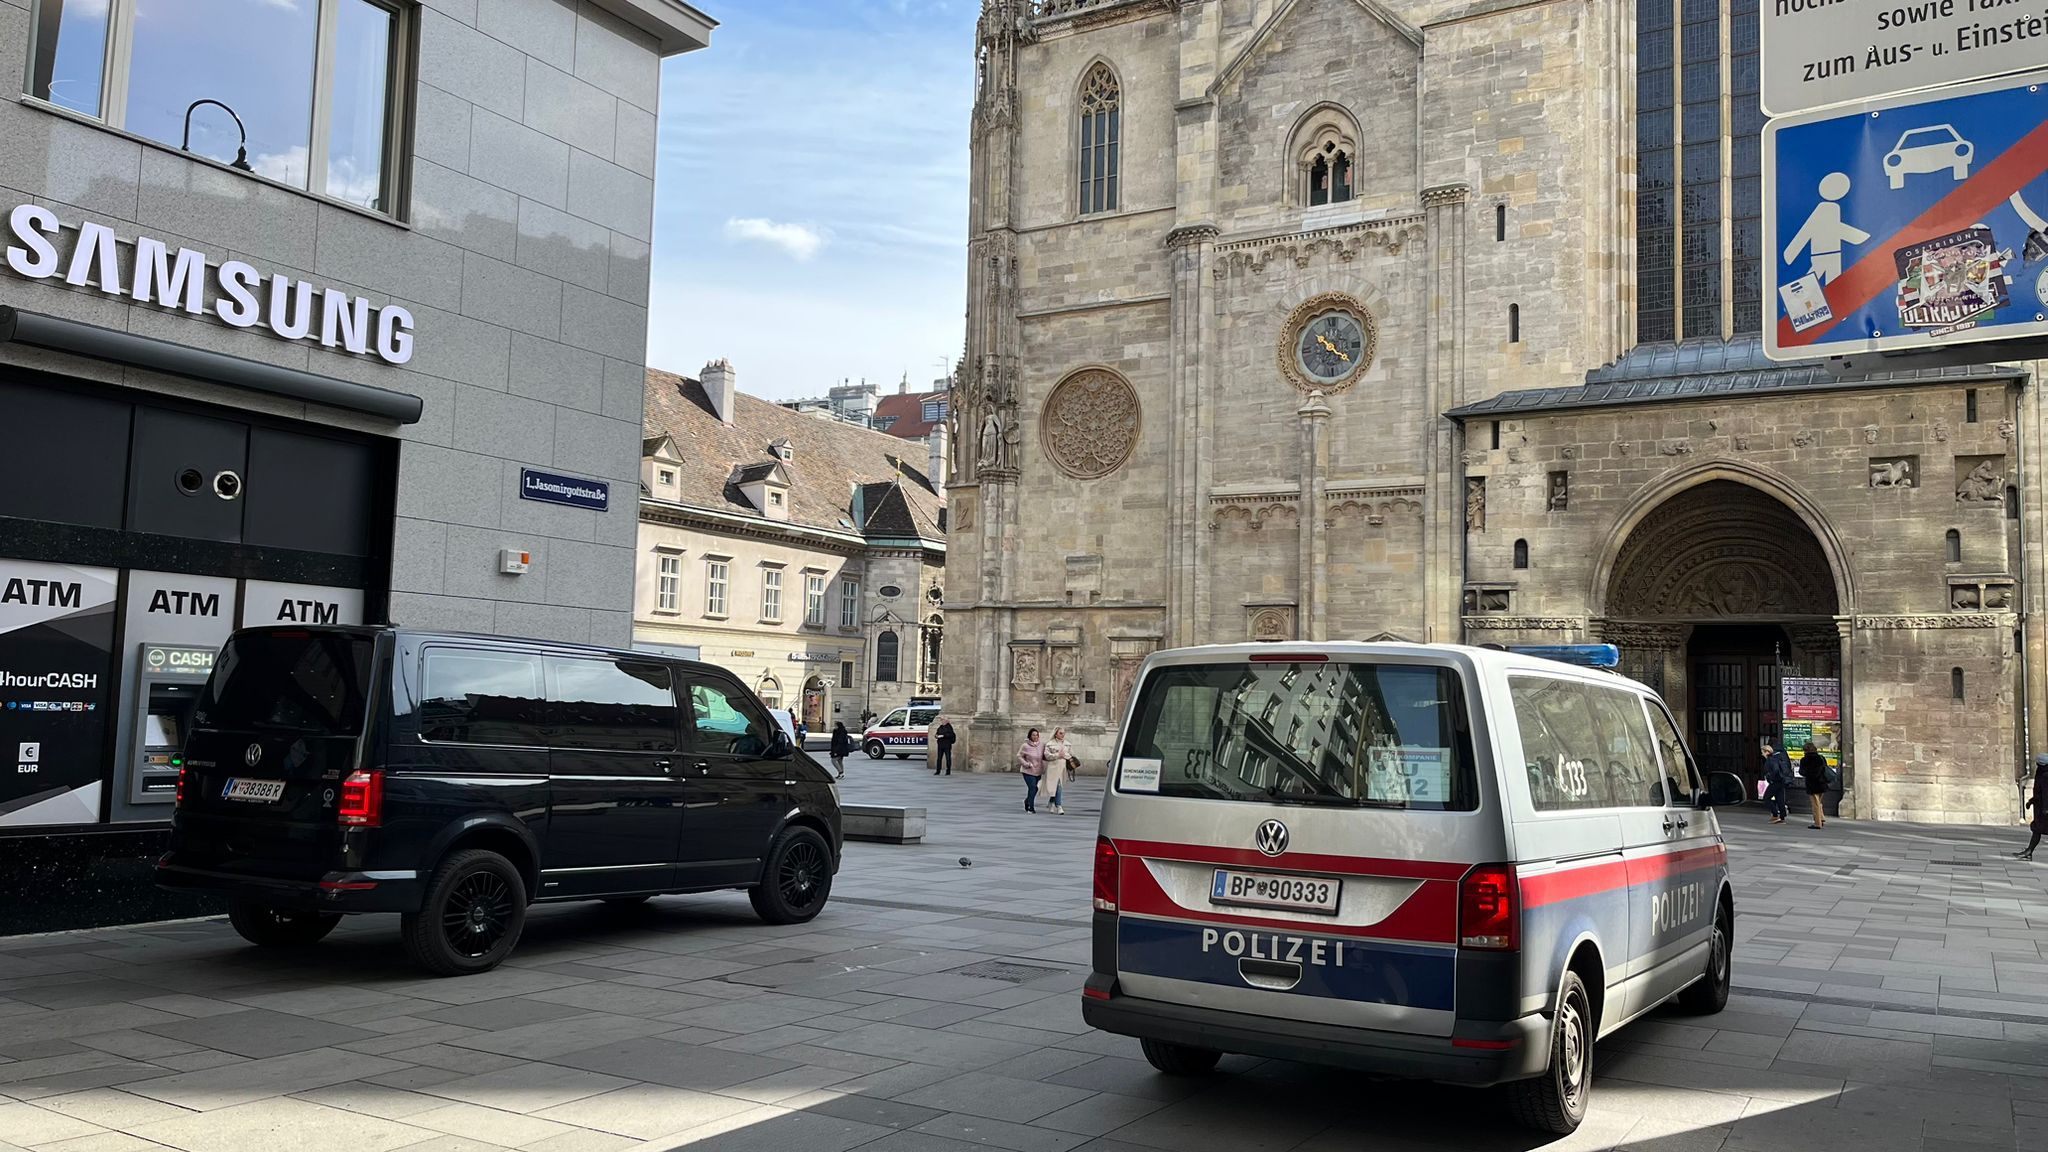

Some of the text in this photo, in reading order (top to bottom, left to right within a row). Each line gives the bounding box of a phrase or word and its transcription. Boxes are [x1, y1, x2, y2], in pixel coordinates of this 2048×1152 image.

[1877, 0, 1954, 30] sowie
[1803, 54, 1855, 82] zum
[1865, 43, 1923, 69] Aus-
[1933, 42, 1949, 57] u.
[6, 204, 415, 364] SAMSUNG
[1, 578, 82, 608] ATM
[149, 589, 219, 617] ATM
[277, 599, 339, 625] ATM
[170, 652, 213, 666] CASH
[889, 736, 919, 744] POLIZEI
[18, 764, 38, 773] EUR
[1231, 876, 1255, 897] BP
[1268, 879, 1329, 904] 90333
[1652, 882, 1699, 936] POLIZEI
[1202, 928, 1344, 967] POLIZEI
